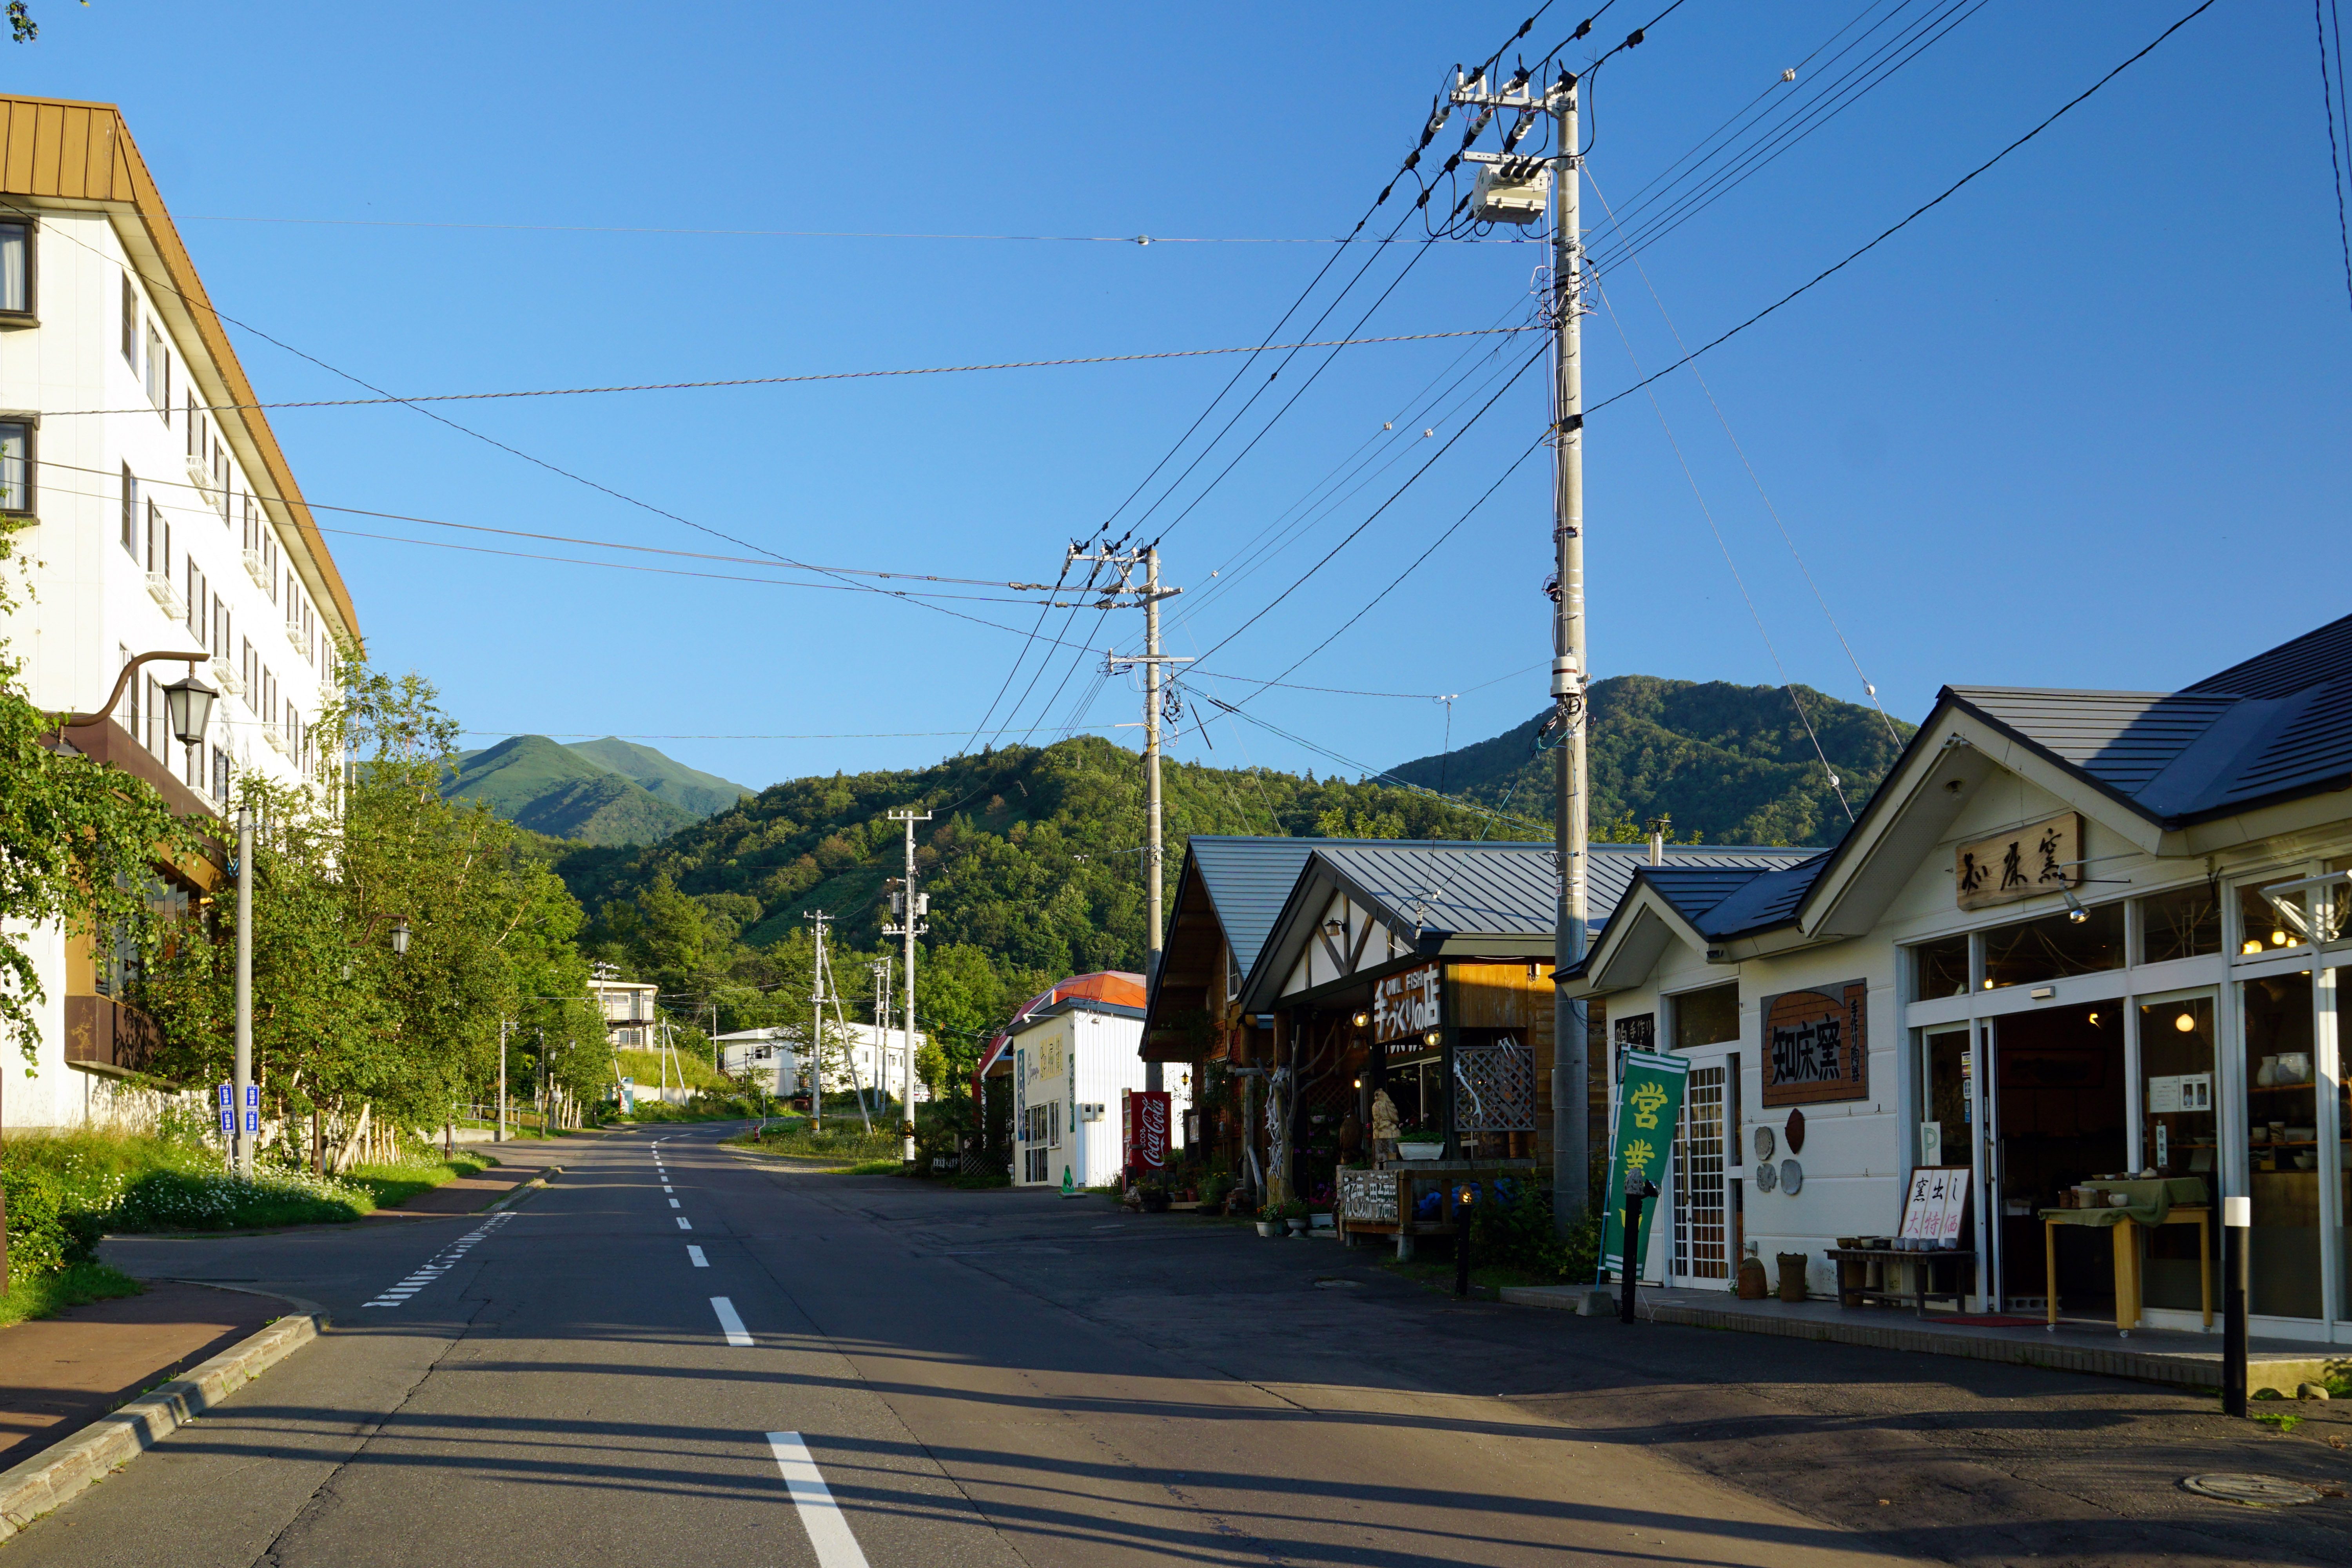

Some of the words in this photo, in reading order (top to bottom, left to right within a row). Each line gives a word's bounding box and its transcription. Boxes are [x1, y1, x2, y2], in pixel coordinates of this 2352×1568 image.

[1374, 963, 1441, 1040] 手づくりの店
[1386, 977, 1403, 996] OWL
[1406, 969, 1424, 991] FISH
[1630, 1019, 1651, 1039] 手作り
[1771, 1013, 1841, 1085] 知床窯
[1850, 999, 1860, 1083] 手作り陶器
[1142, 1095, 1165, 1167] Coca-Cola
[1913, 1177, 1957, 1202] 窯出し
[1906, 1210, 1958, 1236] 大特価
